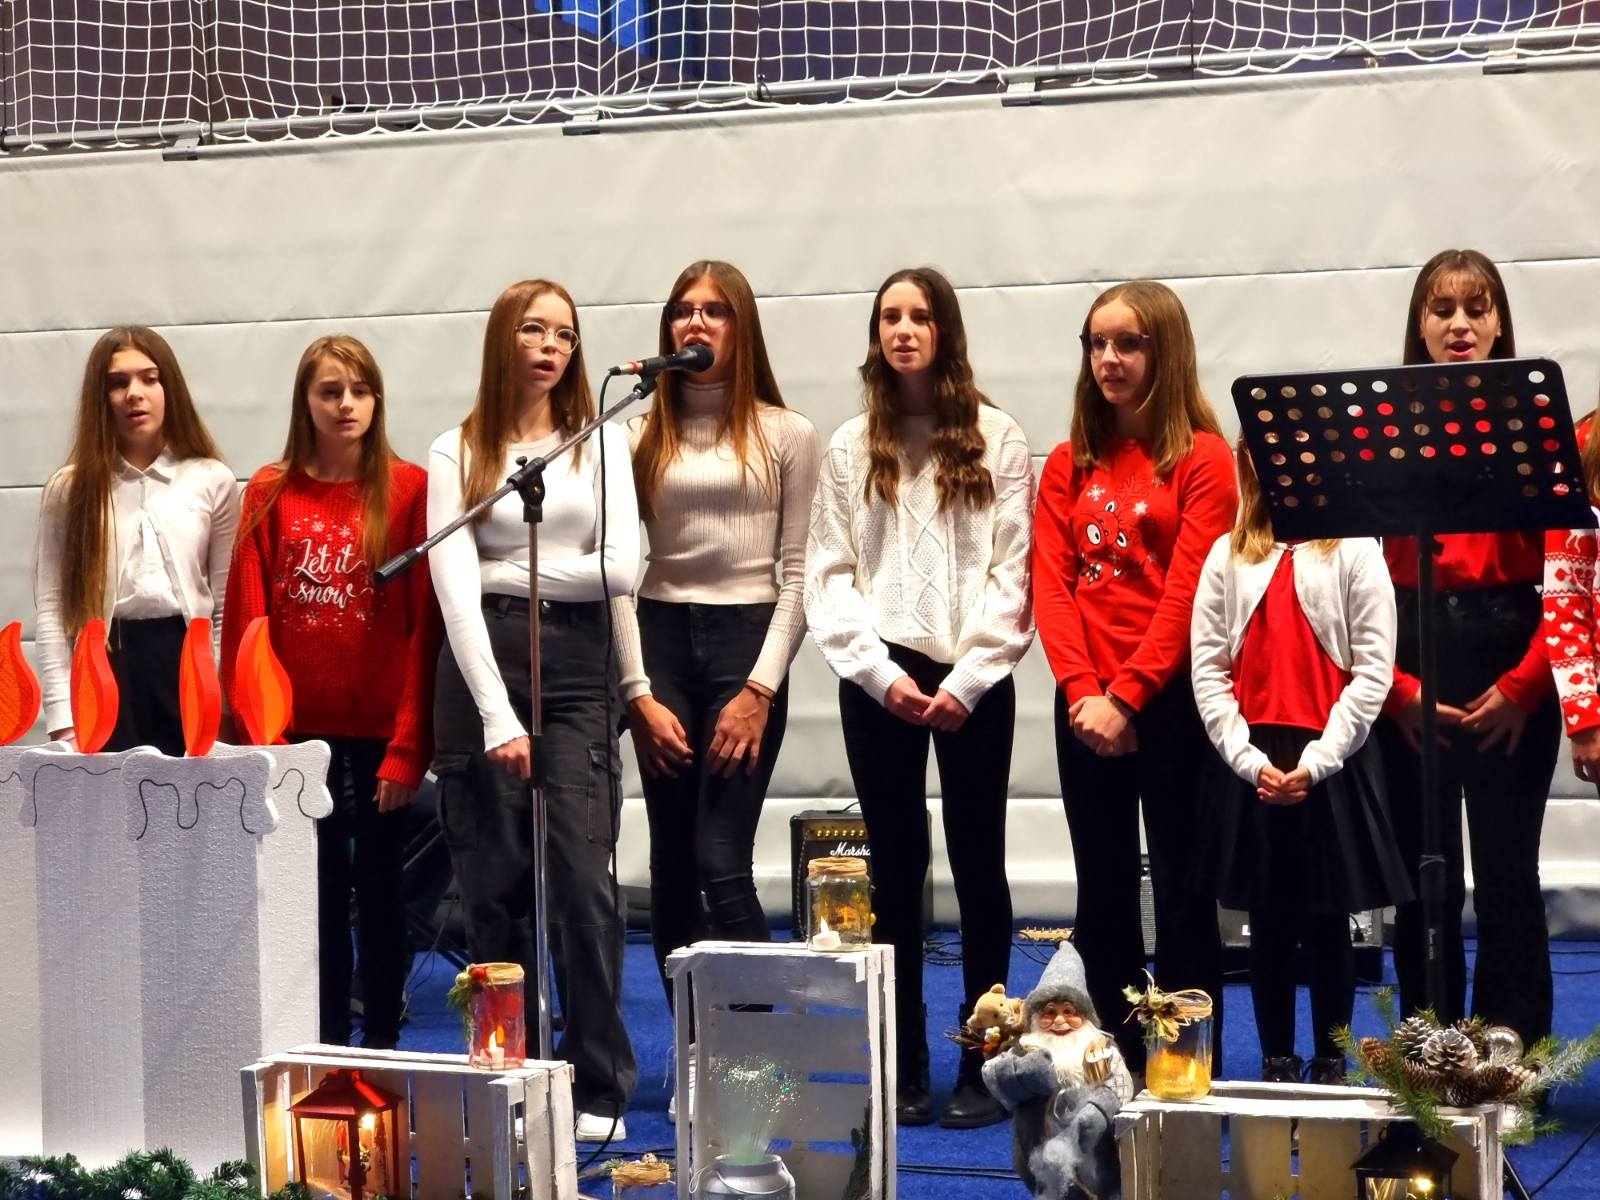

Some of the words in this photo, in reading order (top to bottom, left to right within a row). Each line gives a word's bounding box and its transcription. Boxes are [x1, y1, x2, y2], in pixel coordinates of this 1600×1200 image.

[293, 538, 332, 583] Let
[334, 543, 364, 574] it
[288, 581, 360, 609] snow
